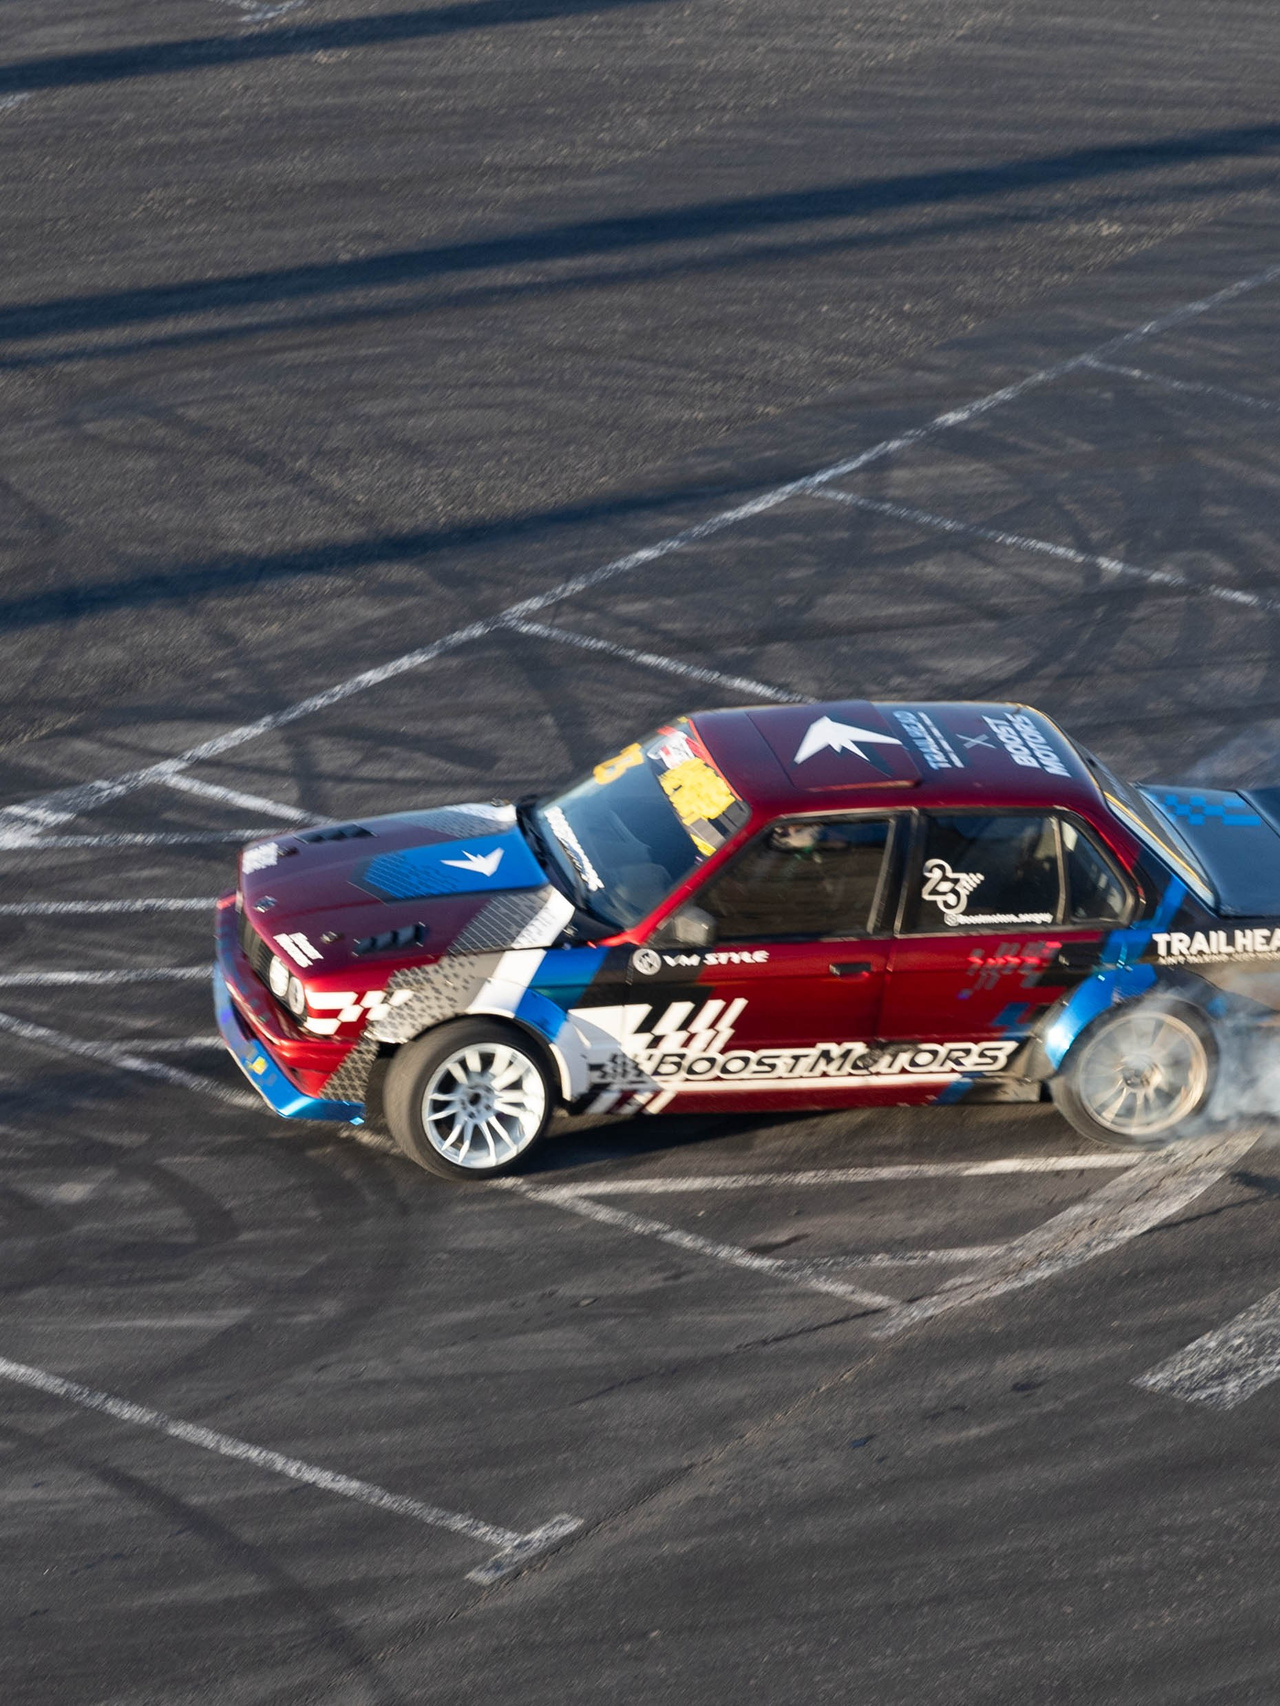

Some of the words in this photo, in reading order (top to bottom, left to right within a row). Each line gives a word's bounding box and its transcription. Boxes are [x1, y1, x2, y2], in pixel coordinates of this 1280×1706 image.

[893, 710, 952, 771] TRAILHEAD
[981, 714, 1041, 768] BOOST
[1004, 711, 1072, 778] MOTORS
[703, 950, 769, 966] STYLE
